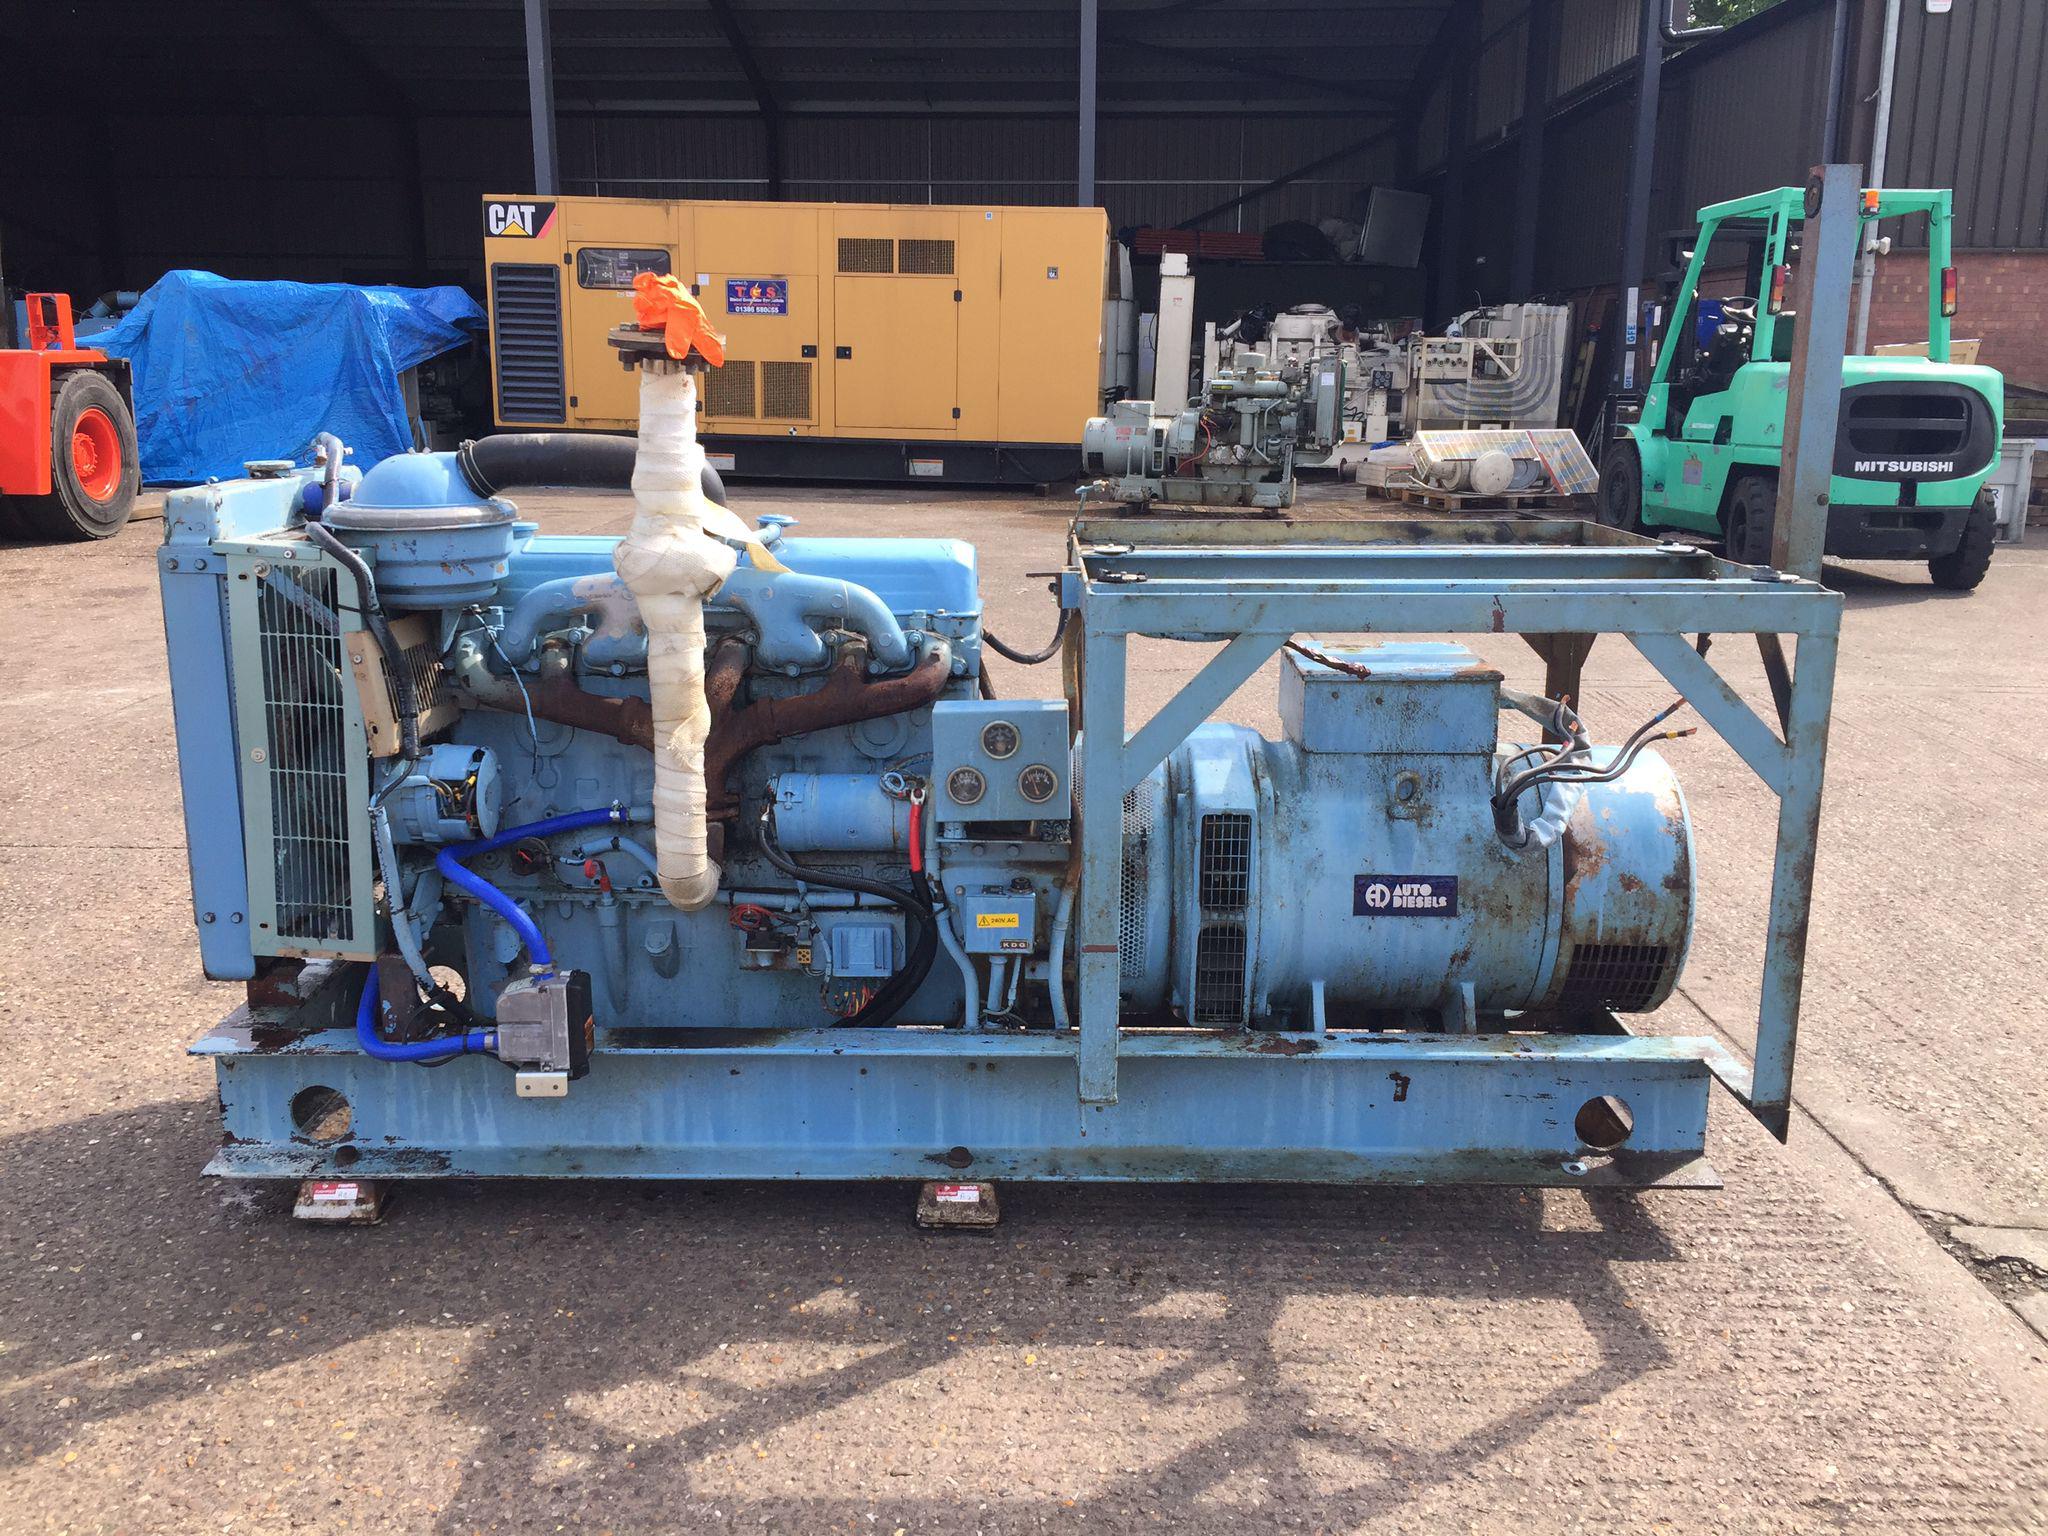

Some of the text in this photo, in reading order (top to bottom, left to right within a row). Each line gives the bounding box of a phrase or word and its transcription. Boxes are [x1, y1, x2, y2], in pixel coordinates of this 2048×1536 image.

[489, 204, 536, 235] CAT
[1854, 461, 1954, 473] MITSUBISHI
[1392, 884, 1432, 896] AUTO
[1392, 896, 1447, 908] DIESELS
